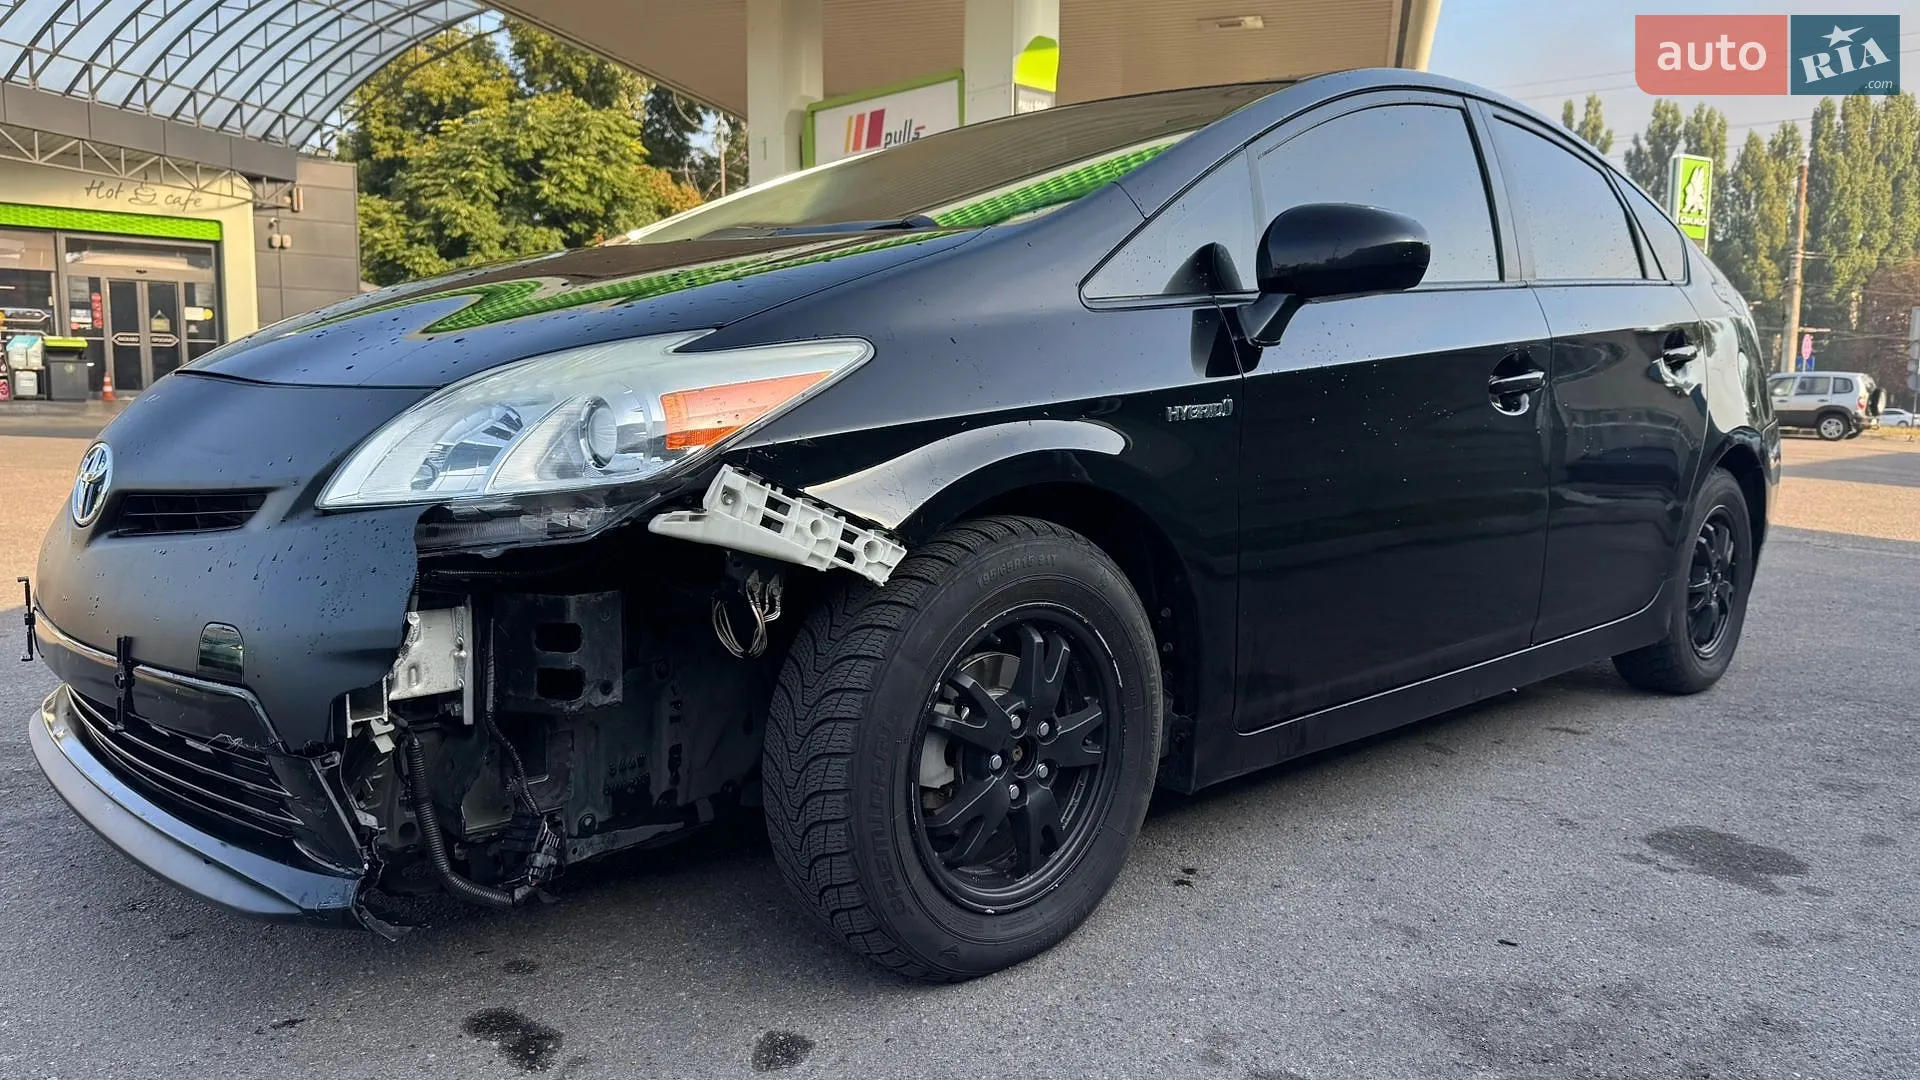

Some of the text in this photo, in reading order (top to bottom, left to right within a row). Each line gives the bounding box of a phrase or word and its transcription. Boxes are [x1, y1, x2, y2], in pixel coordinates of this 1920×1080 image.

[884, 118, 926, 149] pulls
[84, 179, 202, 212] Hot cafe
[1679, 215, 1707, 226] OKKO
[1165, 402, 1224, 422] HYBRID
